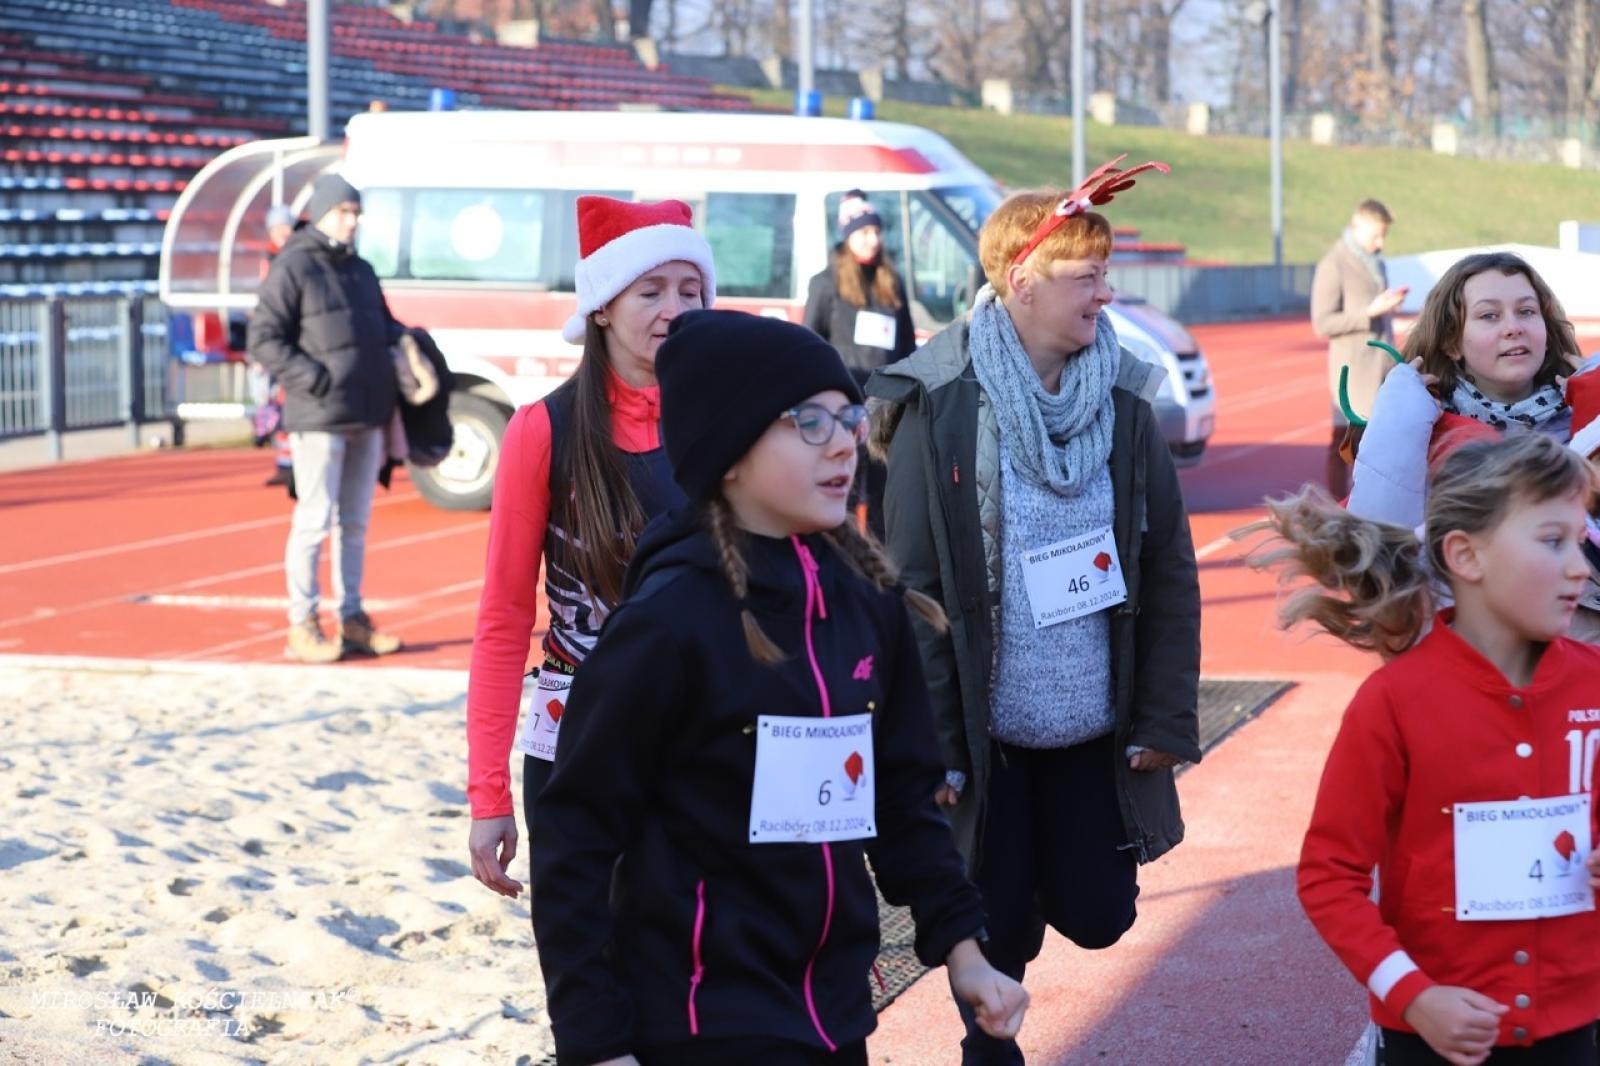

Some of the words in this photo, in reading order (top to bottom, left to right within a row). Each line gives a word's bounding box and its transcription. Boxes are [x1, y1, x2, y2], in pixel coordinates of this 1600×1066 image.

[1029, 553, 1049, 565] BIEG
[1050, 534, 1107, 557] MIKOŁAJKOWY
[1068, 575, 1090, 594] 46
[1041, 606, 1076, 619] Racibórz
[533, 712, 541, 732] 7
[772, 725, 801, 738] BIEG
[805, 723, 867, 739] MIKOŁAJKOWY
[818, 779, 832, 806] 6
[1466, 809, 1497, 822] BIEG
[1502, 804, 1581, 820] MIKOŁAJKOWY
[760, 819, 811, 834] Racibórz
[1528, 859, 1544, 883] 4
[1468, 899, 1525, 911] Racibórz
